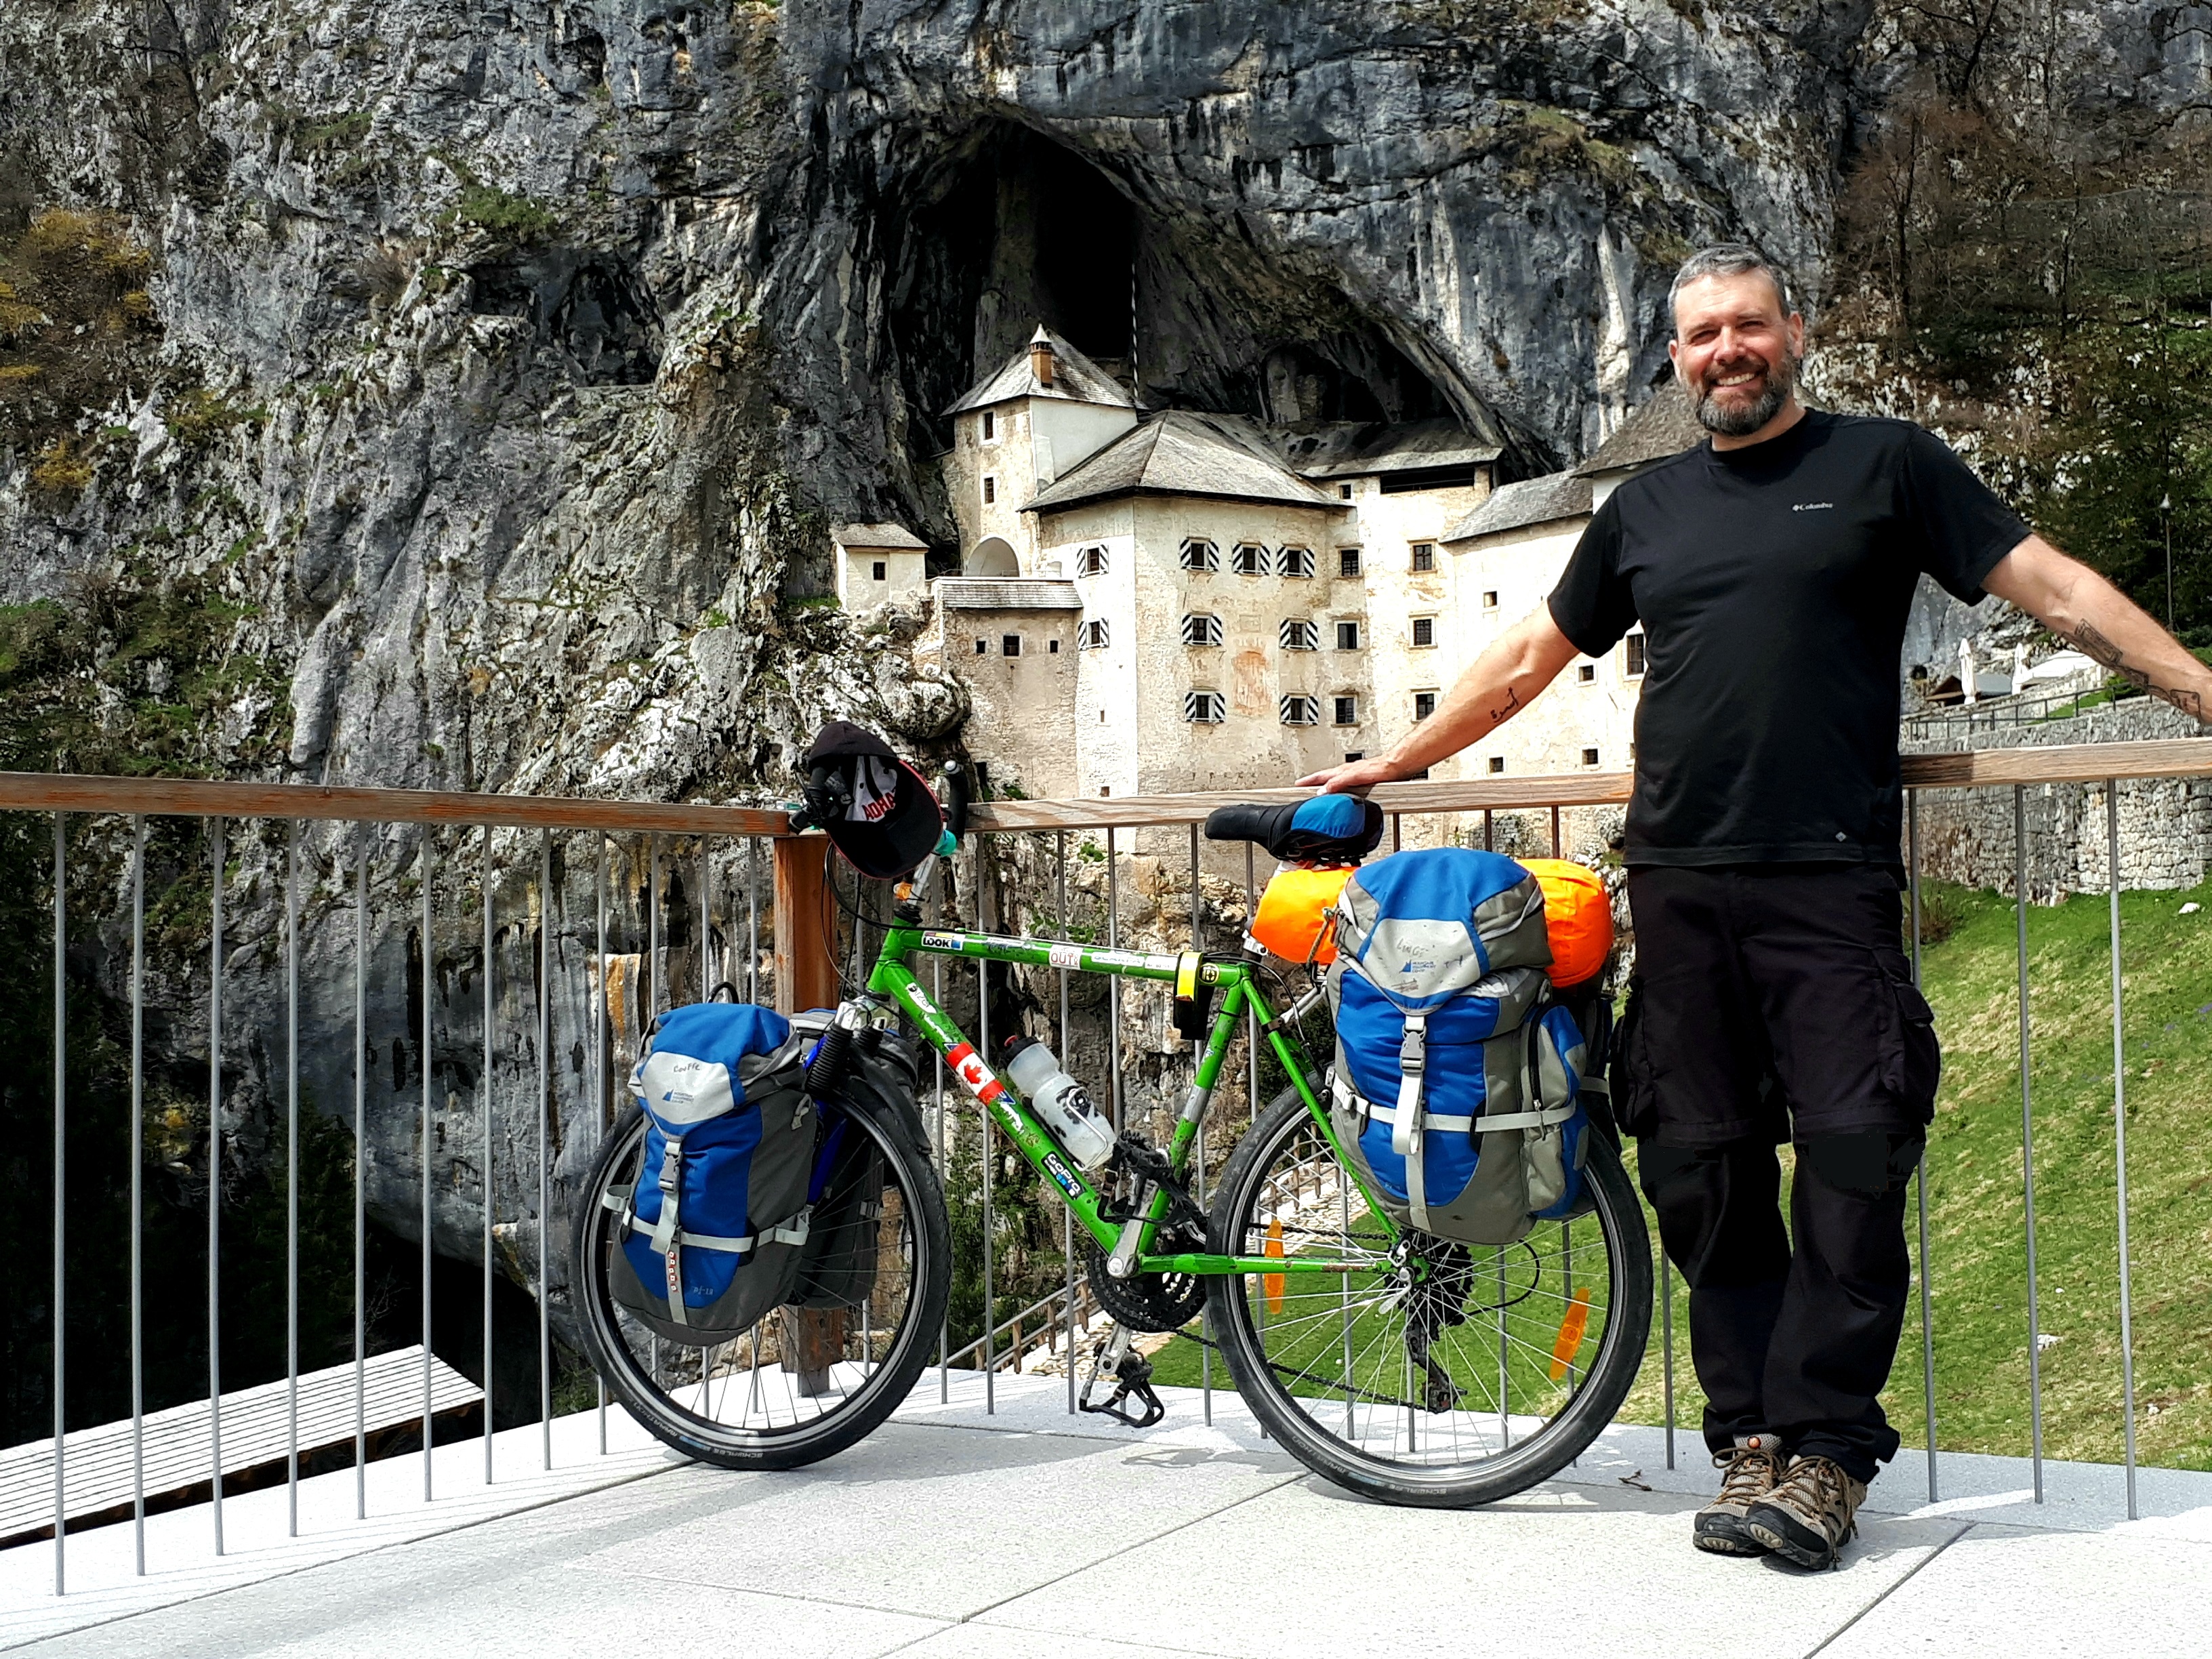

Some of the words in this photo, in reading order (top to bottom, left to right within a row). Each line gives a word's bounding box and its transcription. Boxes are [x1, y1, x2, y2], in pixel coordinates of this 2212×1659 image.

[923, 937, 950, 947] LOOK
[1050, 952, 1073, 966] OUT
[1047, 1153, 1081, 1193] GoPro
[714, 1448, 763, 1458] SCHWALBE
